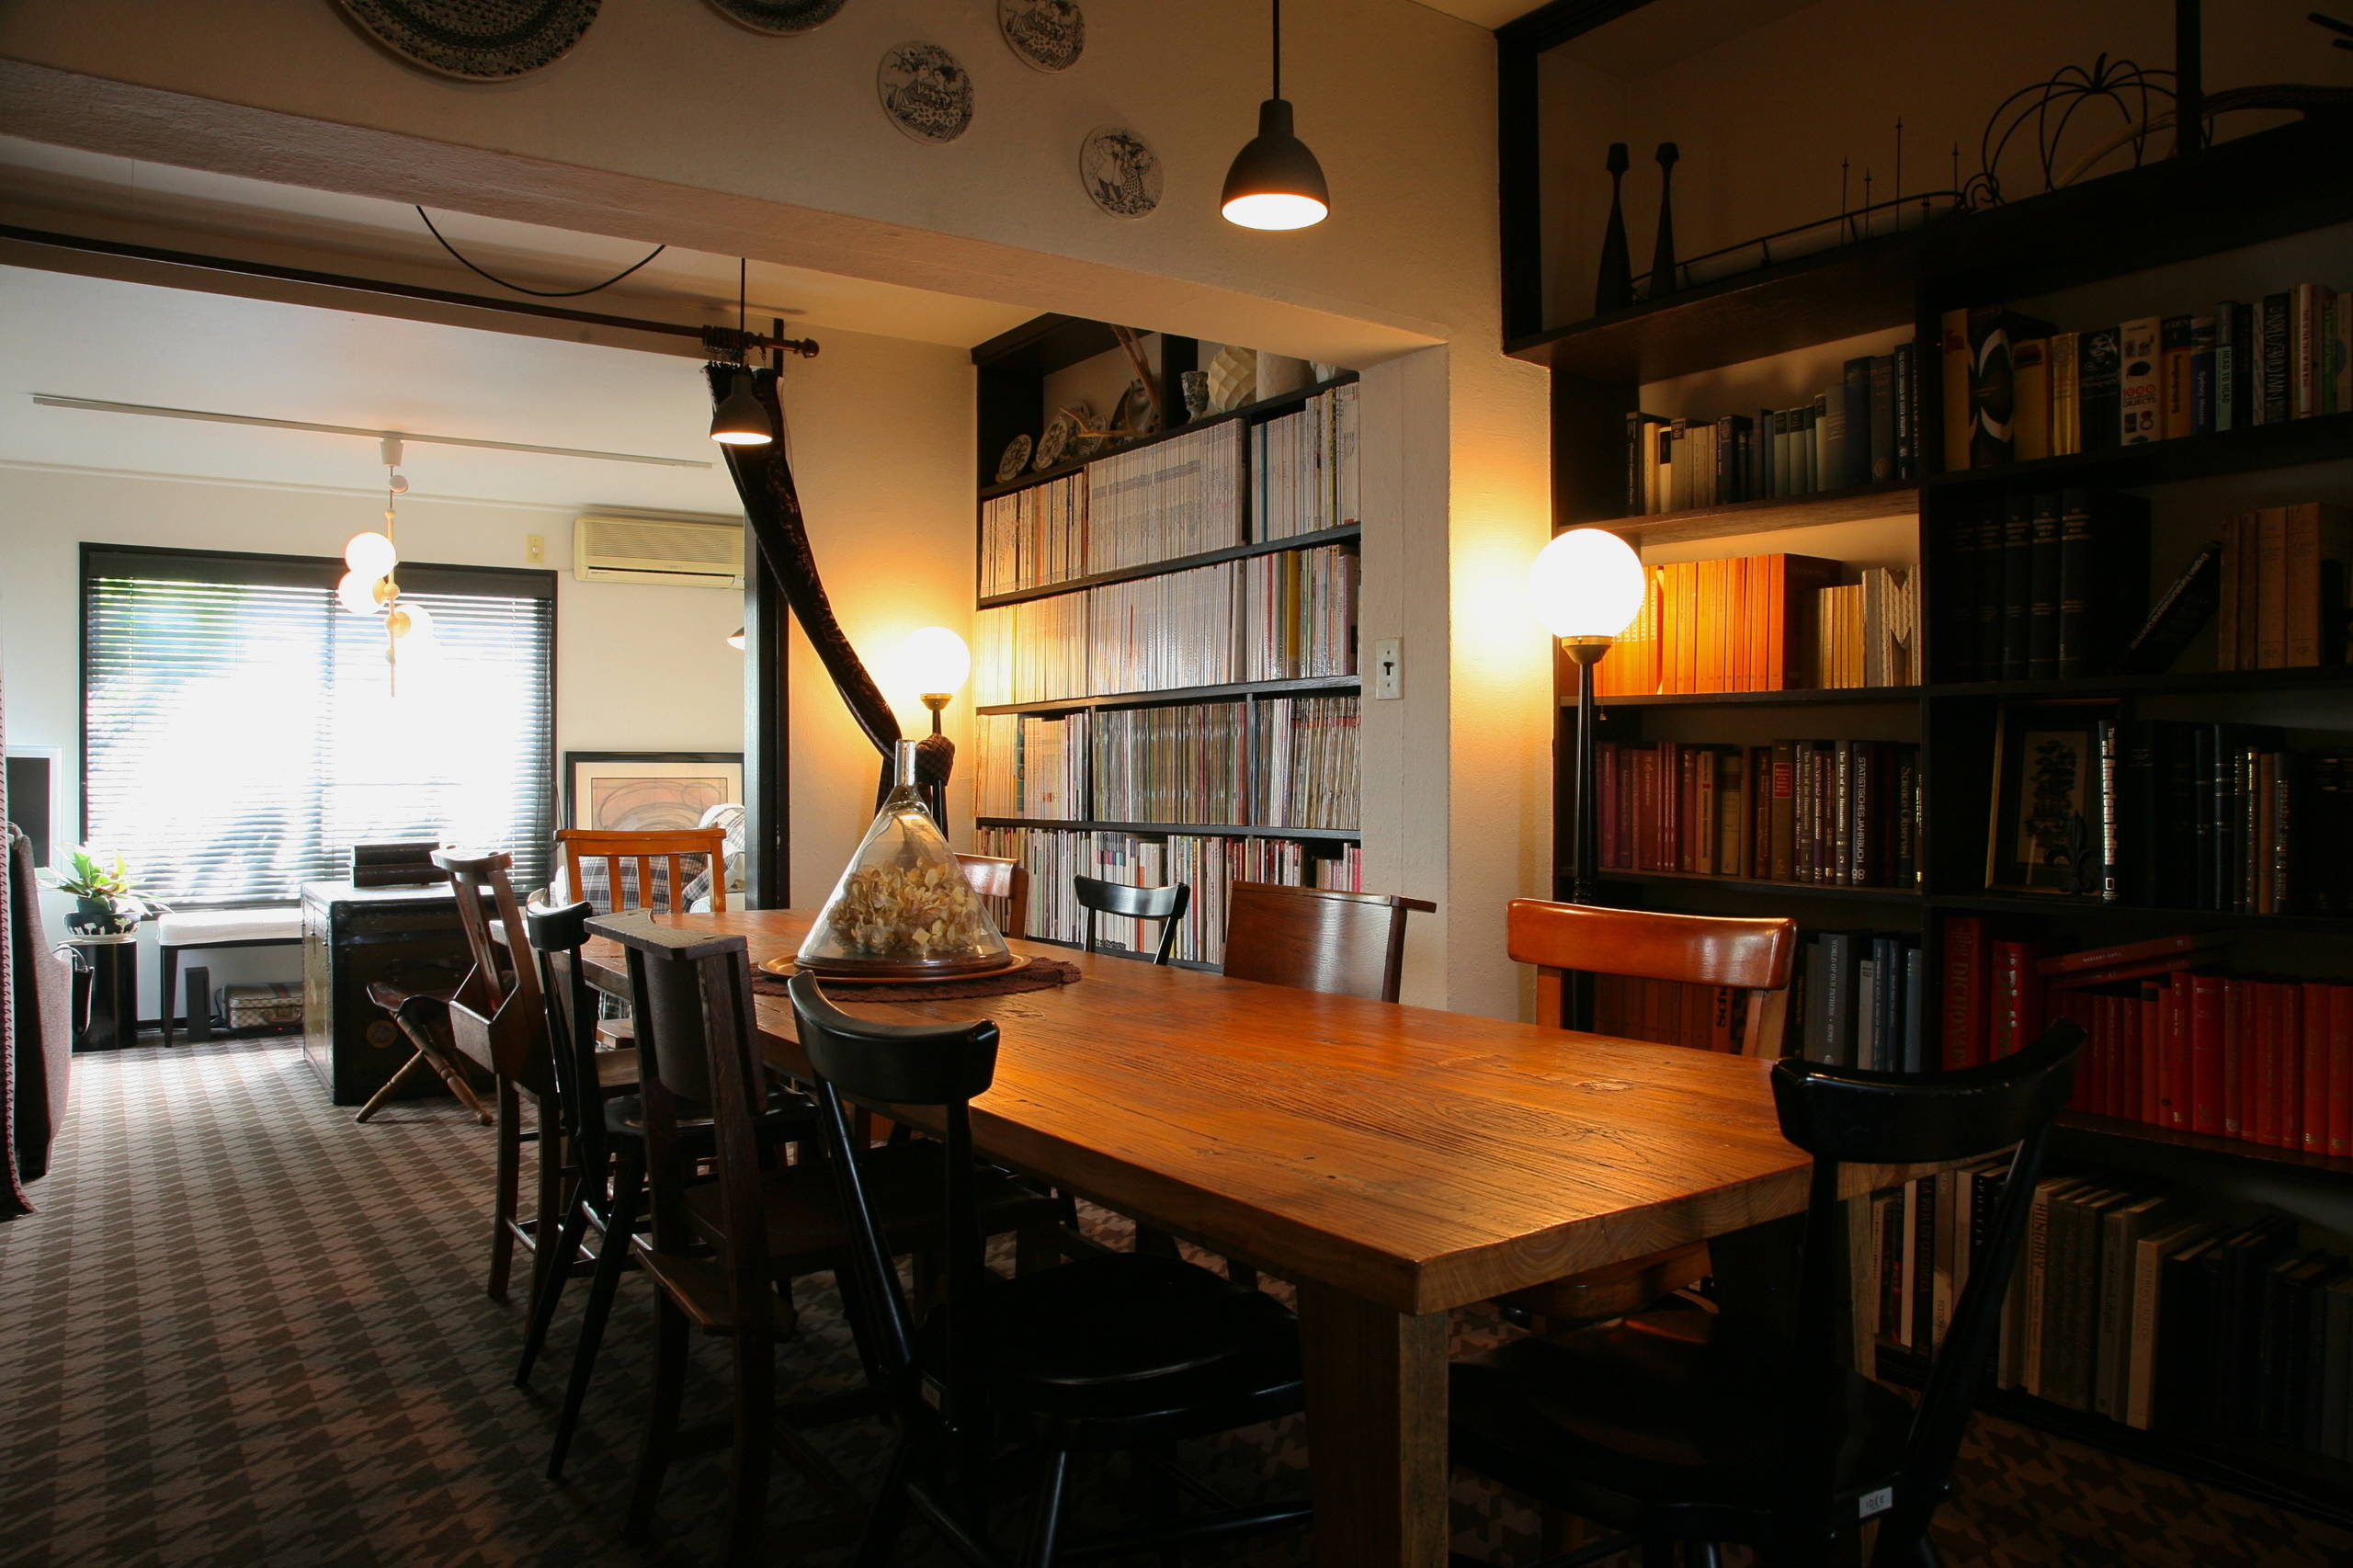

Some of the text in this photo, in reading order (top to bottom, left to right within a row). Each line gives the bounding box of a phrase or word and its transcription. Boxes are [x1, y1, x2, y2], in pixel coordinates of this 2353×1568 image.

[2123, 384, 2155, 398] 1000
[2222, 350, 2231, 403] HEAD TO HEAD
[1899, 766, 1913, 808] Science
[2102, 757, 2117, 823] American
[1856, 756, 1866, 863] STATISTISCHES JAHRBUCH
[2104, 824, 2118, 866] Indian
[1830, 939, 1838, 962] WORLD
[1829, 973, 1837, 987] OUR
[2032, 1203, 2048, 1269] HUNGARY
